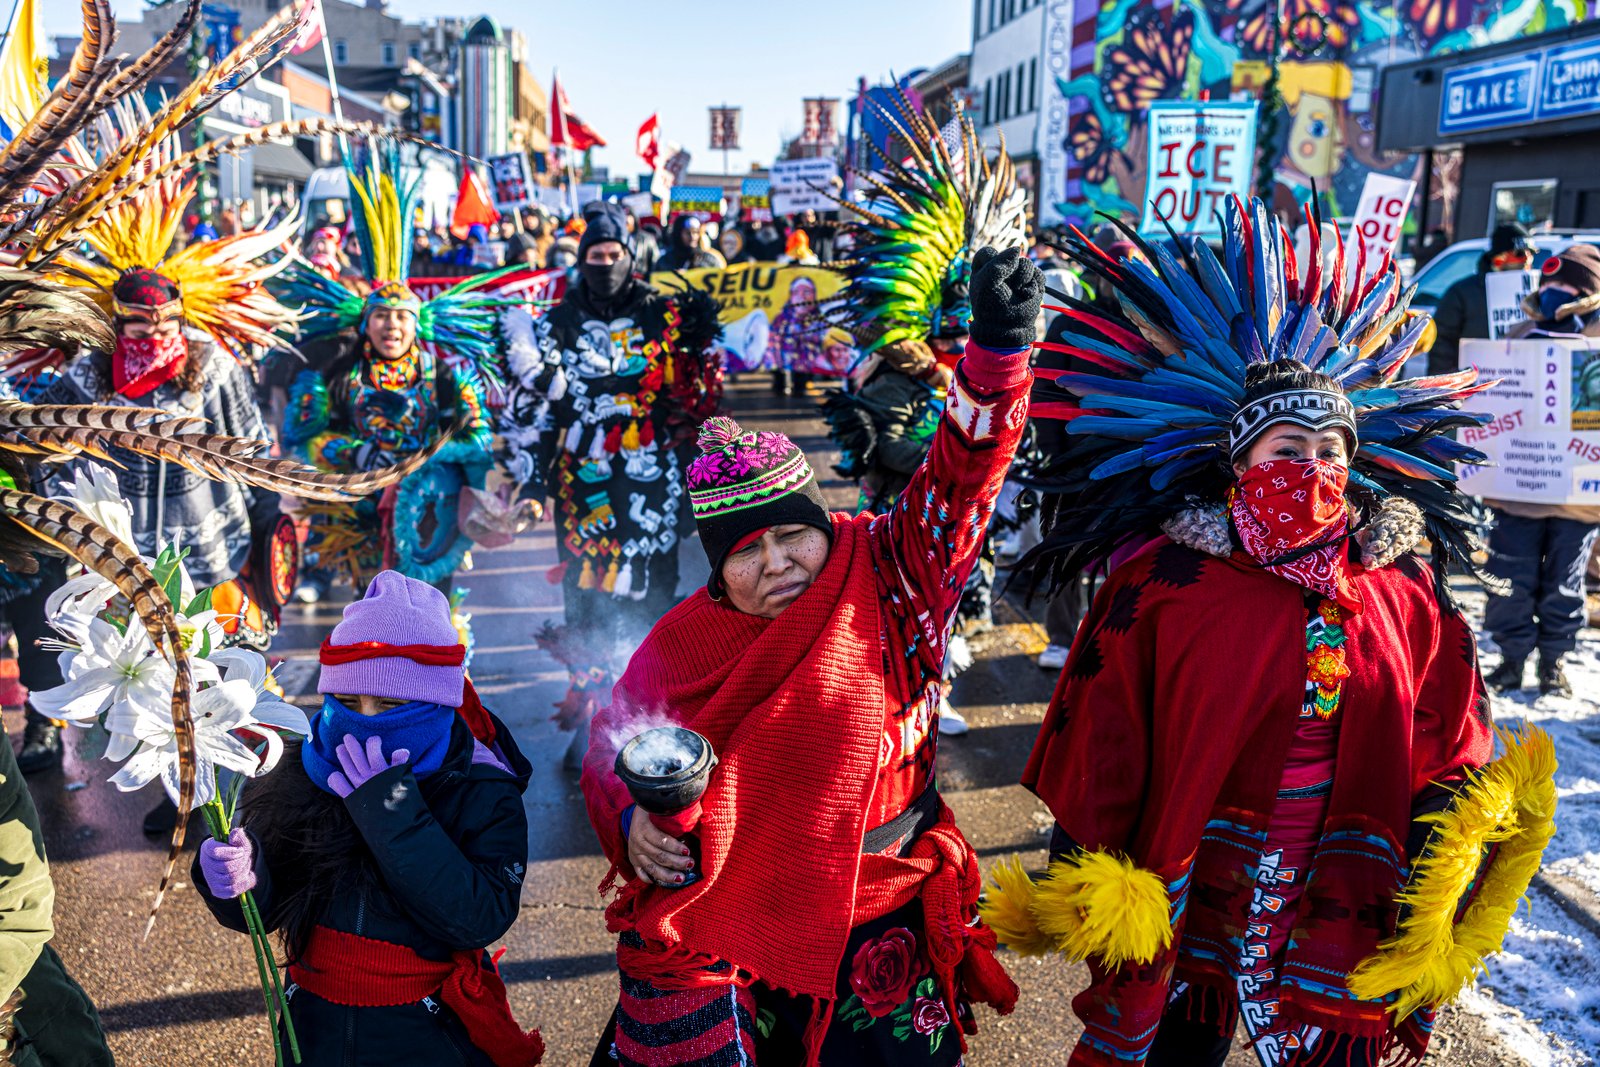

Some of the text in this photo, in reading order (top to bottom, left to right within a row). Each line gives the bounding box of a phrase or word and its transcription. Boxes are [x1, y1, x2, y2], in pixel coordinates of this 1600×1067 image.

[1552, 58, 1600, 85] Laun
[1158, 141, 1235, 184] ICE
[1153, 187, 1225, 223] OUT
[1374, 195, 1404, 217] IC
[1362, 219, 1398, 243] OU
[702, 267, 778, 295] SEIU
[719, 294, 772, 309] CAL 26
[1463, 409, 1523, 443] RESIST
